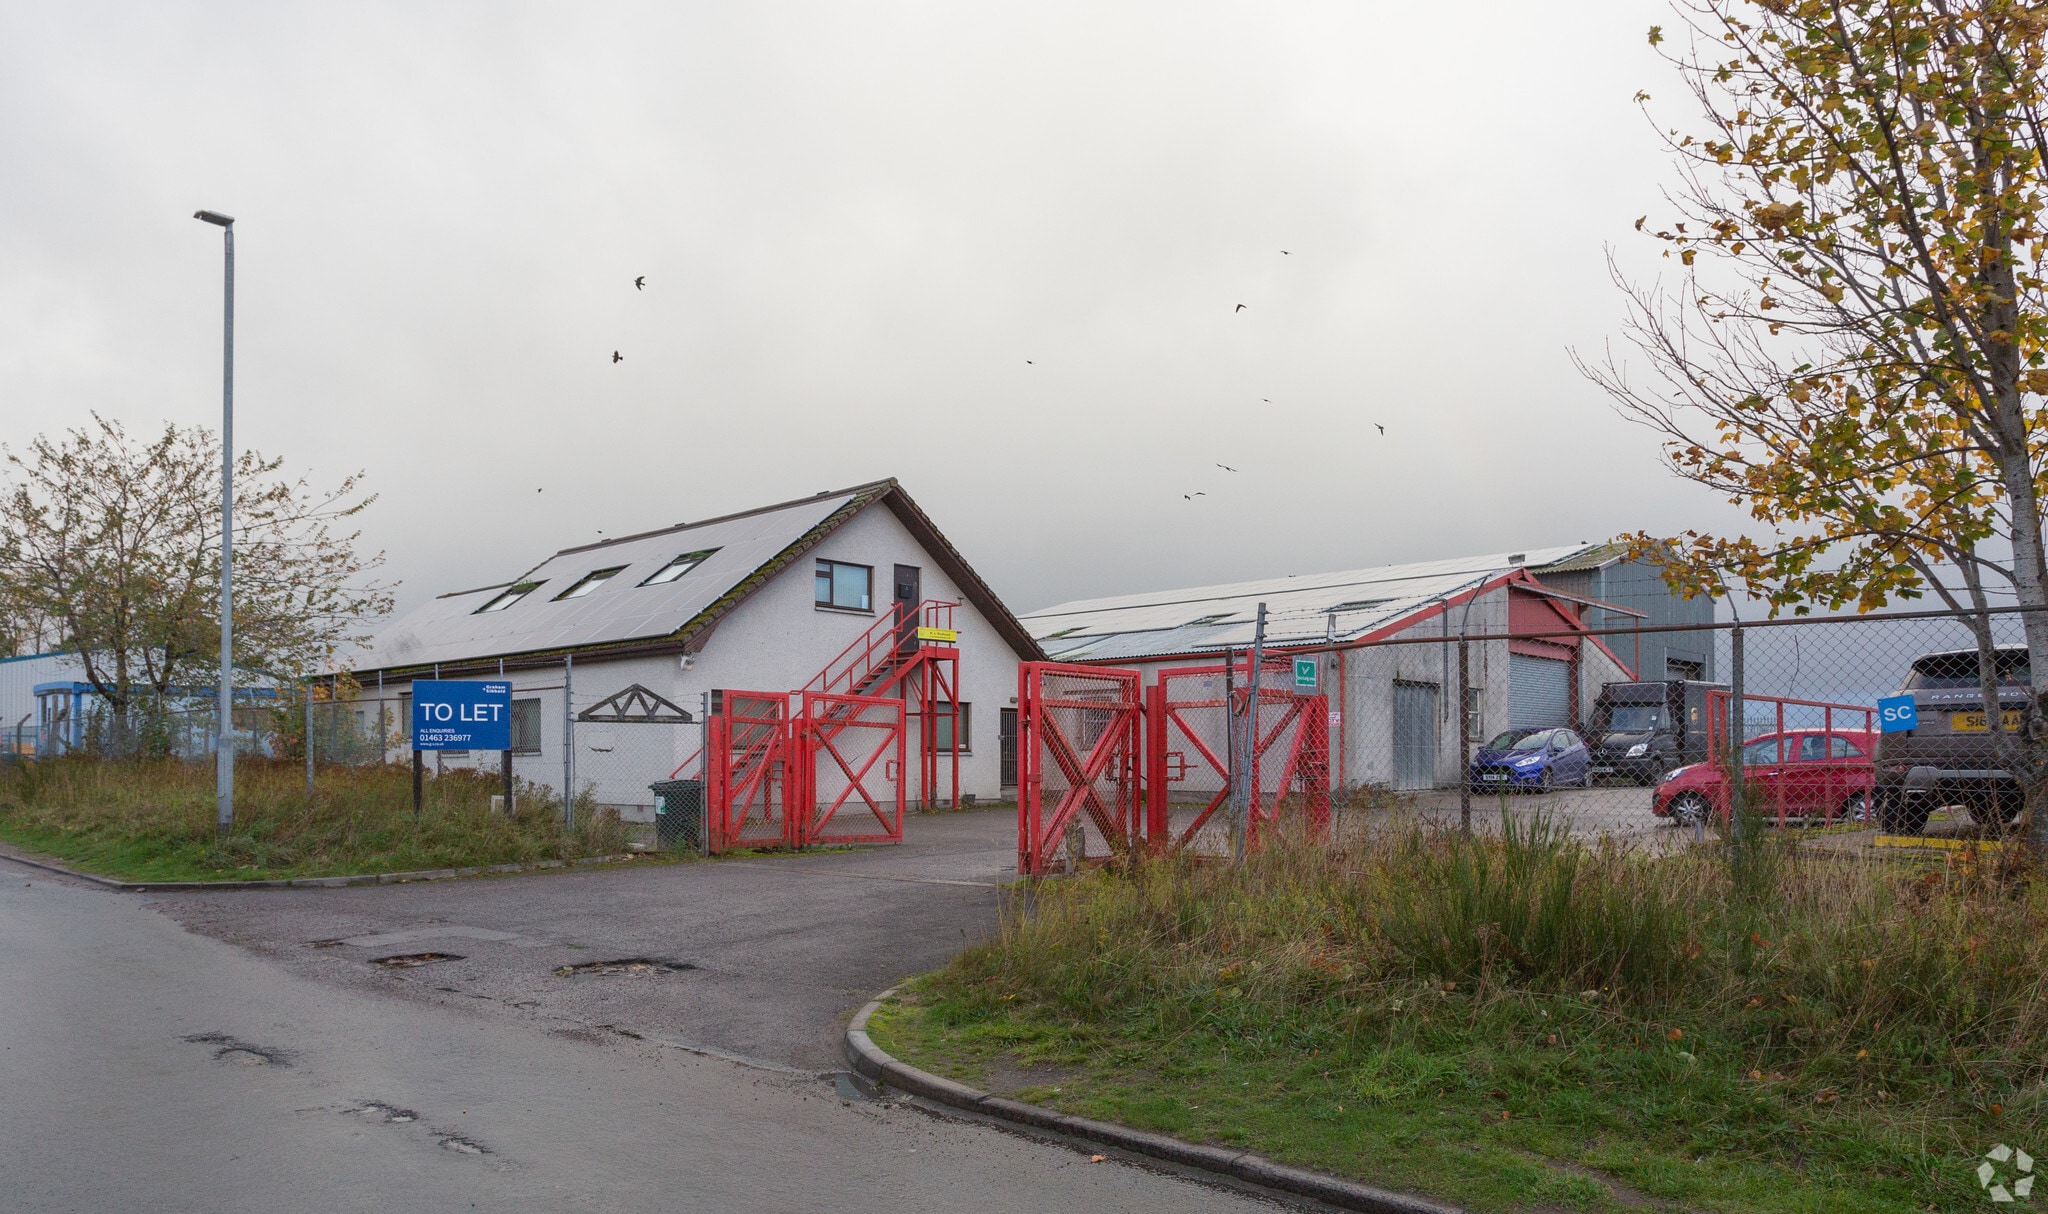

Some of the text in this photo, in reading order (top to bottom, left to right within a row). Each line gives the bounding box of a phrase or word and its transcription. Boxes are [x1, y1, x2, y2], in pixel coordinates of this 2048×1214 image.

[420, 703, 503, 721] TO LET
[1883, 705, 1912, 721] SC
[420, 734, 471, 742] 01463 236977
